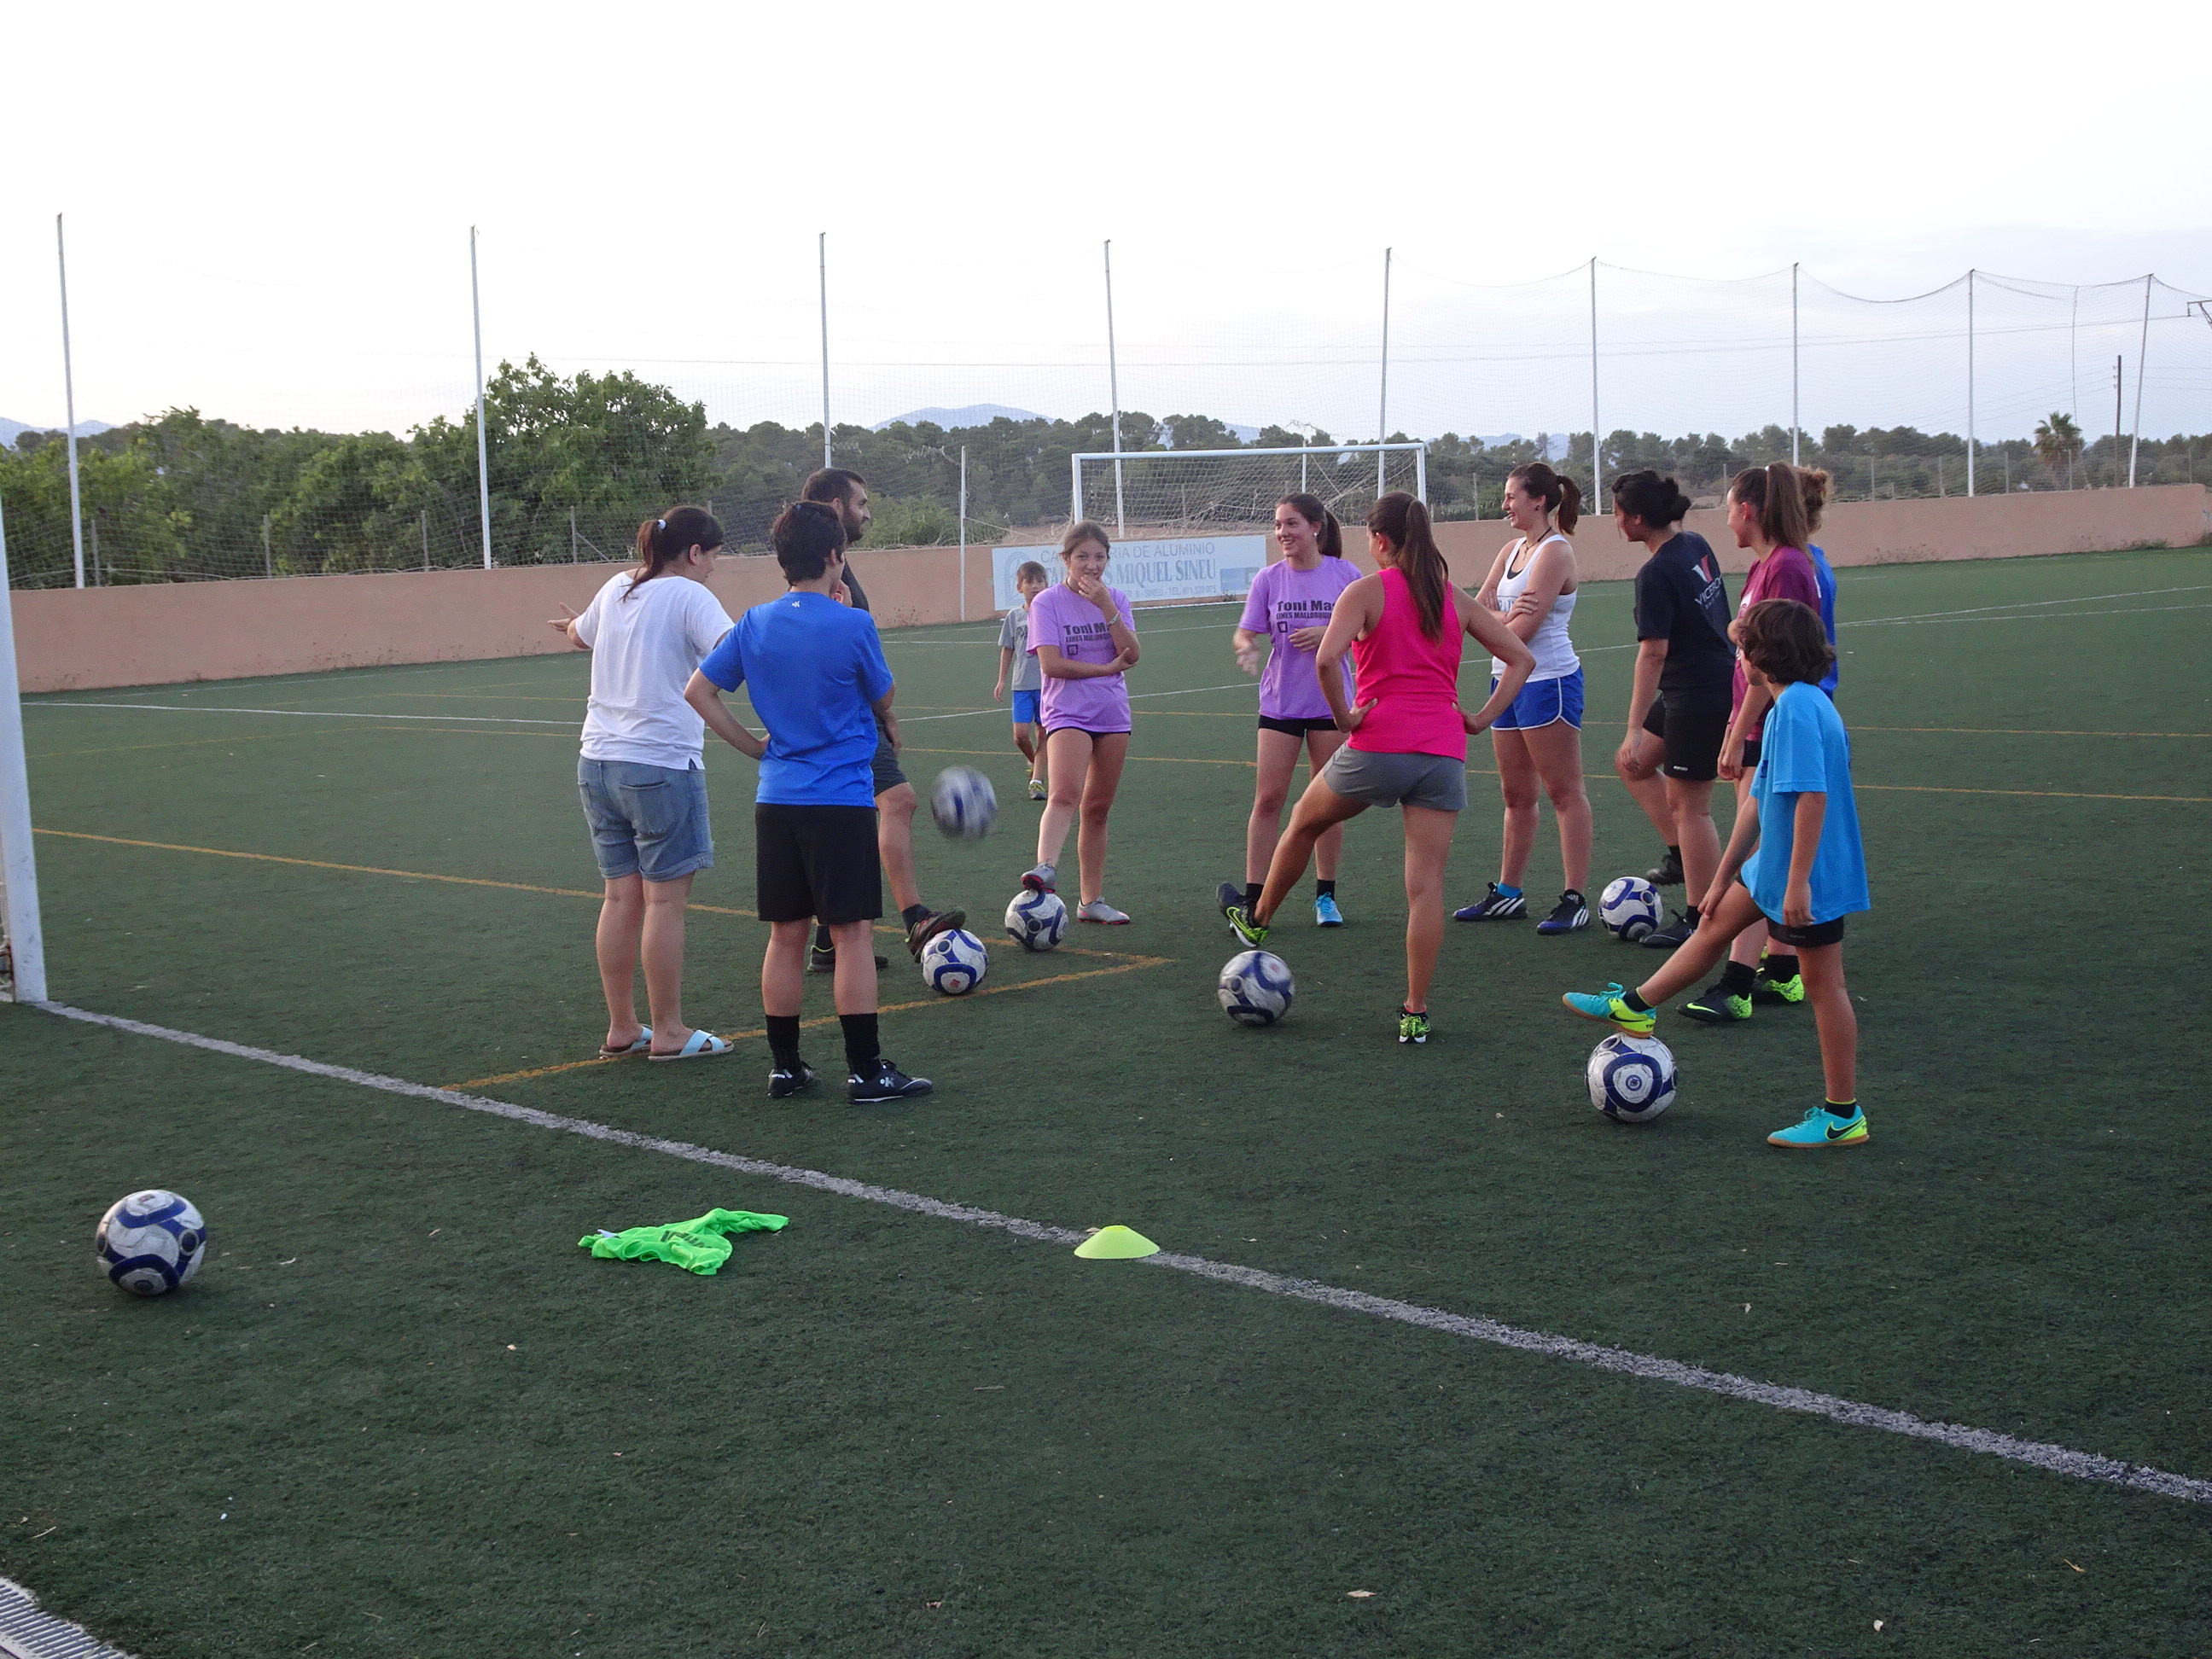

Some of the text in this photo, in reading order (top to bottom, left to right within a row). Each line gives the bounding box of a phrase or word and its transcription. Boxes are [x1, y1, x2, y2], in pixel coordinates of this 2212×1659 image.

[1133, 545, 1151, 559] DE
[1154, 542, 1215, 557] ALUMINIO
[1116, 561, 1173, 588] MIQUEL
[1175, 558, 1216, 582] SINEU
[1277, 600, 1307, 612] Toni
[1063, 624, 1092, 635] Toni
